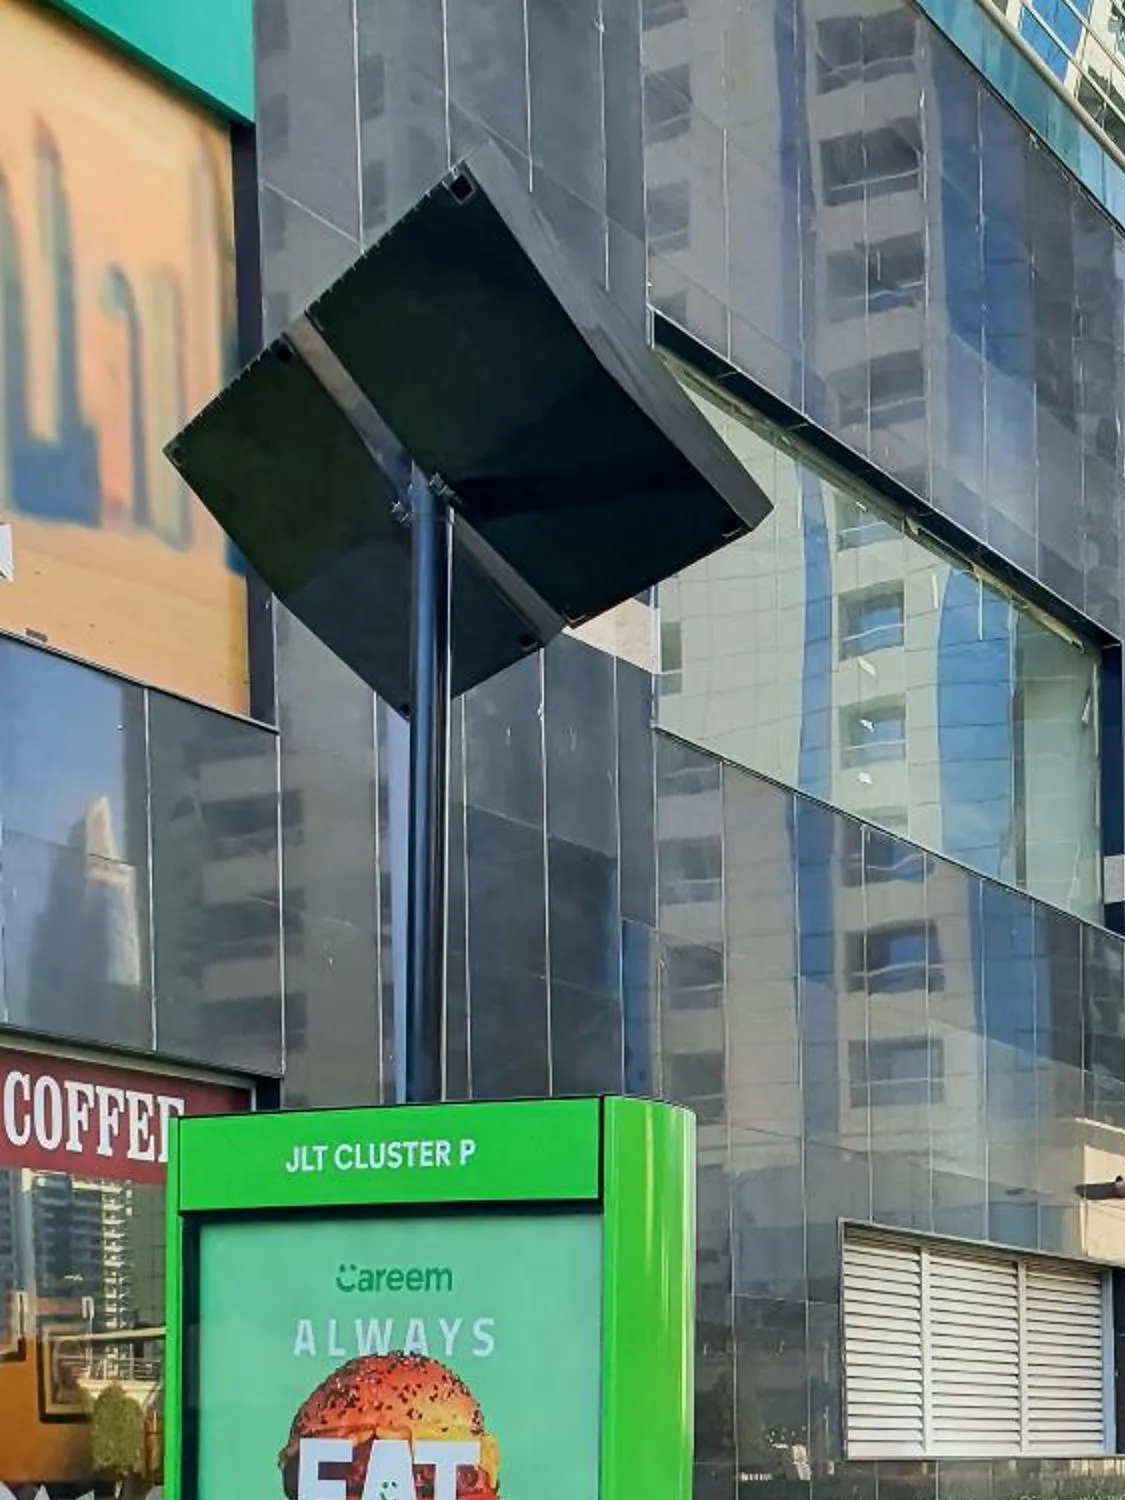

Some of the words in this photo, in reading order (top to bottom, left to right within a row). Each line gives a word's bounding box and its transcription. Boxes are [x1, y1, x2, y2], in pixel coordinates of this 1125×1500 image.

[286, 1145, 328, 1173] JLT
[334, 1140, 451, 1170] CLUSTER
[459, 1139, 477, 1165] P
[336, 1263, 453, 1293] Careem
[293, 1317, 496, 1357] ALWAYS
